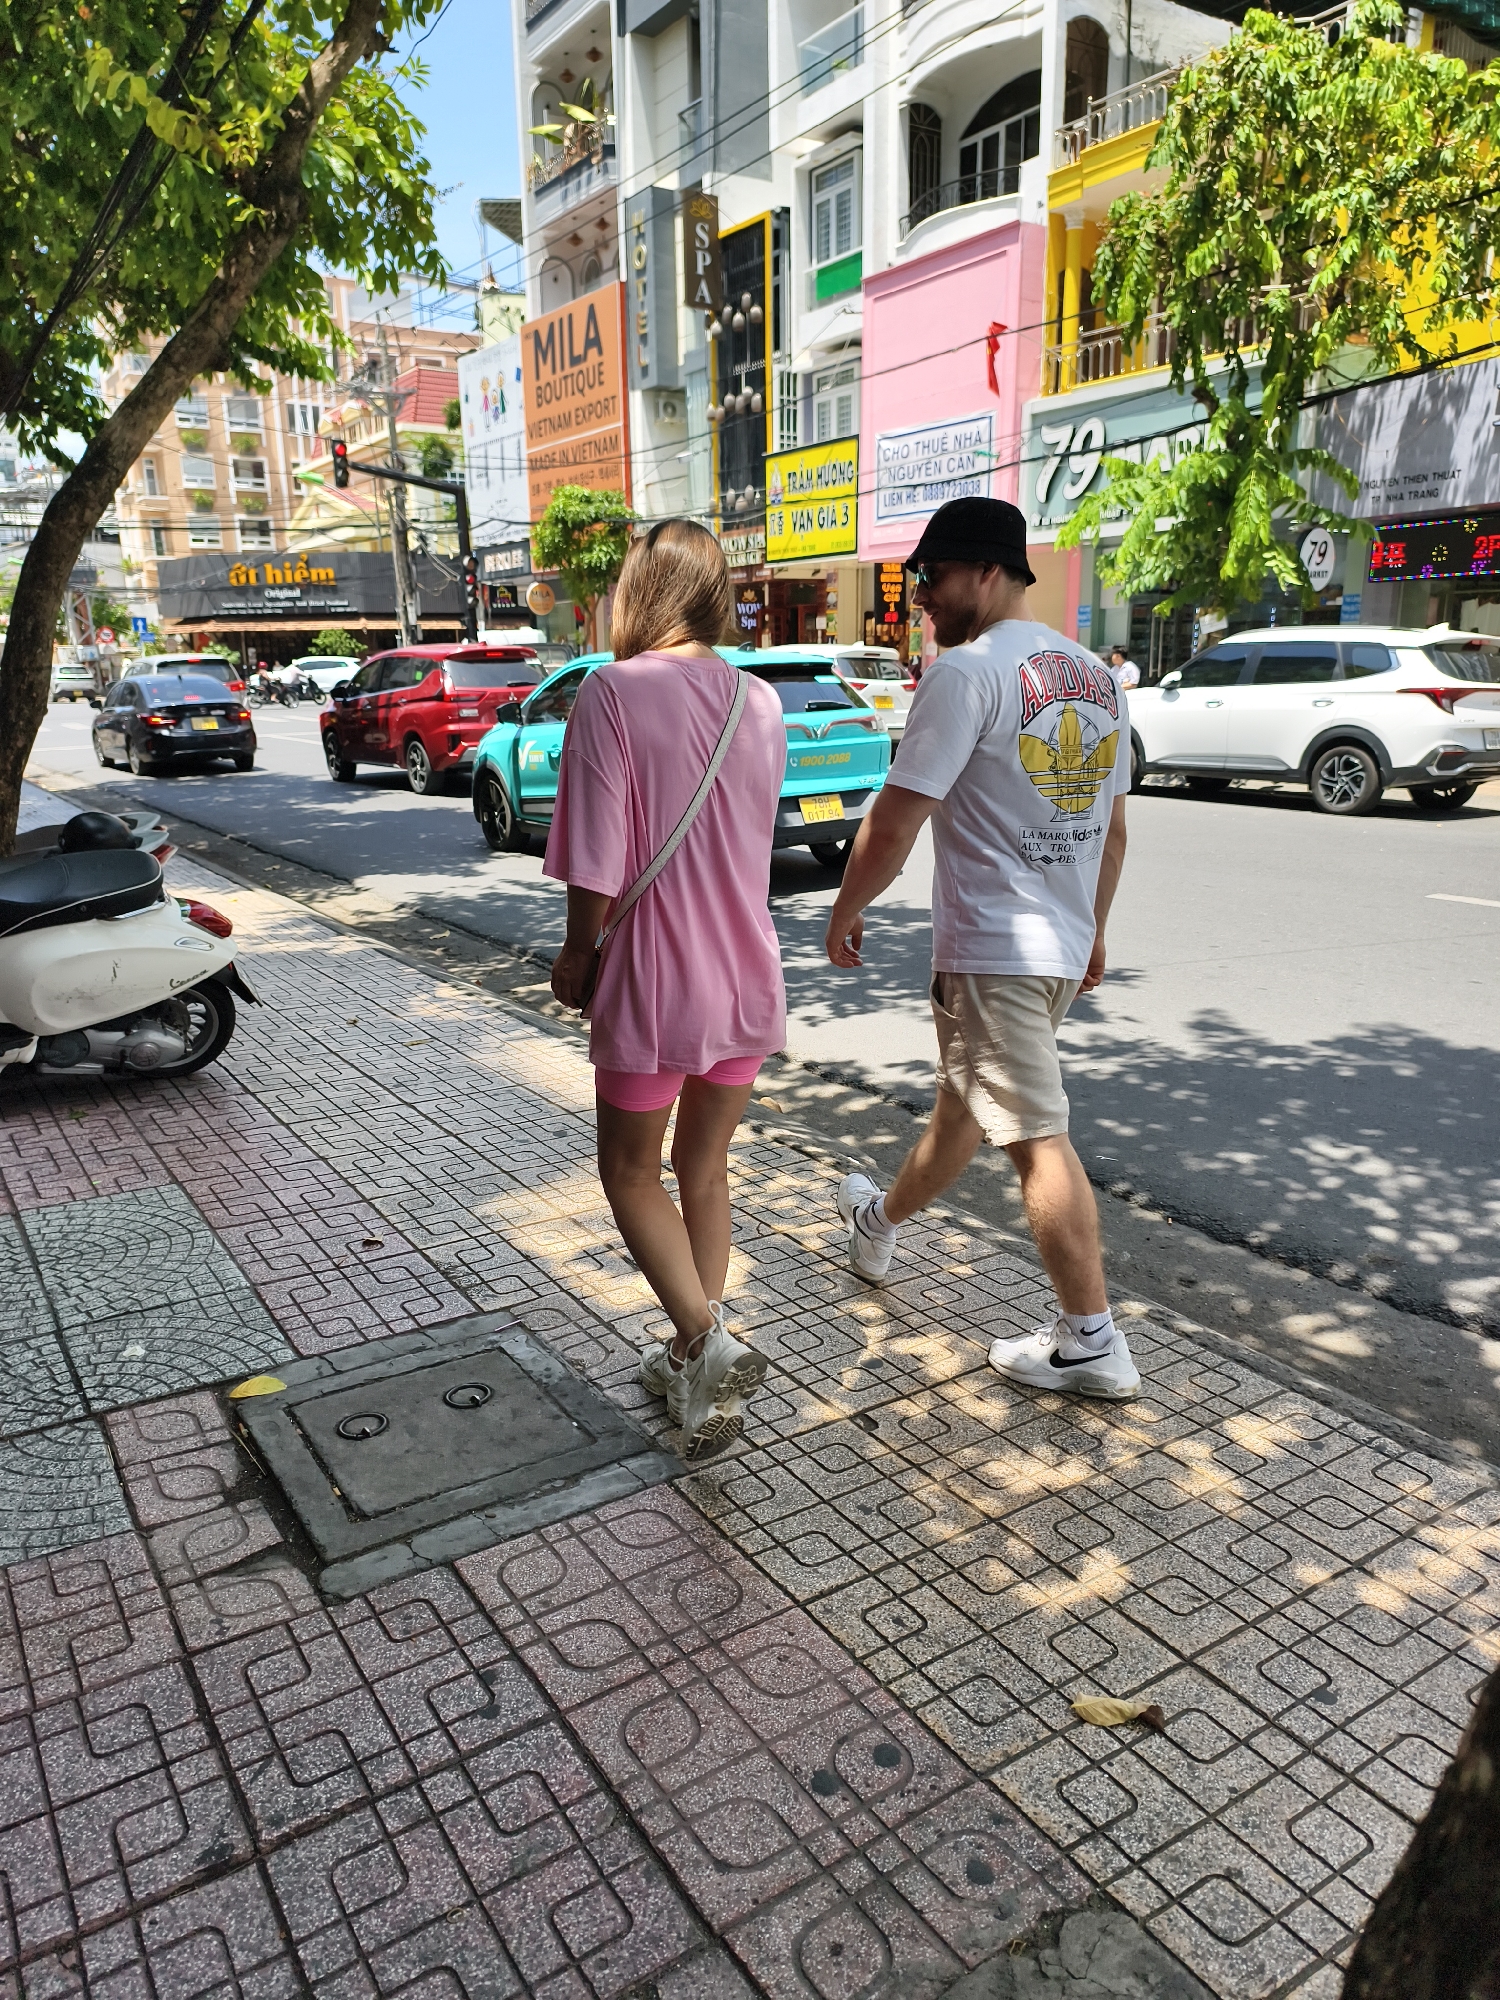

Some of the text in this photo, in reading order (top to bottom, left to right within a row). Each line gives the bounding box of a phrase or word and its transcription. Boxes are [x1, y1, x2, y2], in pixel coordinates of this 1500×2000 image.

[694, 222, 713, 305] SPA
[631, 208, 649, 368] HOTEL
[533, 303, 603, 382] MILA
[535, 361, 604, 409] BOUTIQUE
[527, 395, 617, 440] VIETNAM EXPORT
[571, 434, 620, 464] VIETNAM
[882, 444, 910, 462] CHO
[953, 426, 982, 450] NHÀ
[1035, 417, 1106, 504] 79
[1408, 487, 1439, 501] TRANG
[841, 502, 850, 526] 3
[1308, 540, 1328, 567] 79
[1309, 570, 1328, 578] ARKET
[1018, 650, 1120, 731] ADIDAS
[799, 756, 824, 767] 1900
[1020, 843, 1042, 852] AUX
[1022, 830, 1036, 839] LA
